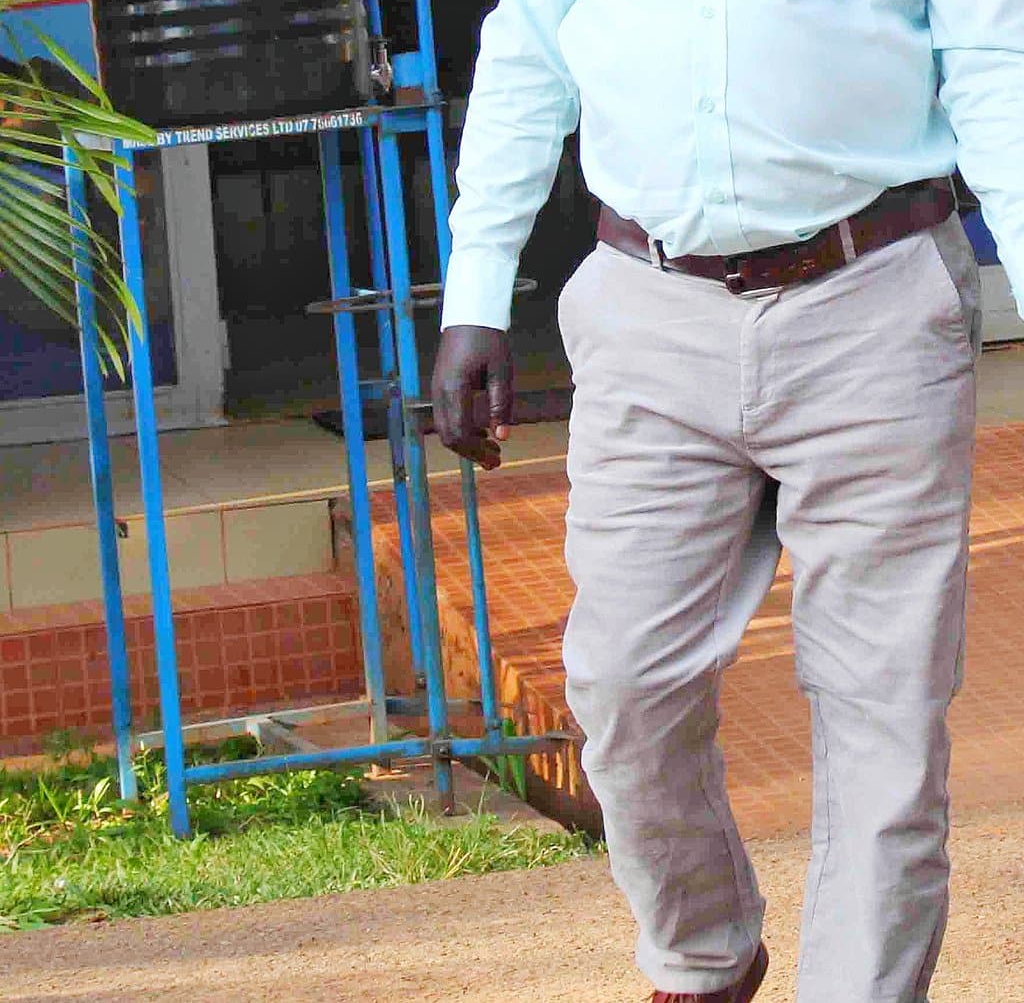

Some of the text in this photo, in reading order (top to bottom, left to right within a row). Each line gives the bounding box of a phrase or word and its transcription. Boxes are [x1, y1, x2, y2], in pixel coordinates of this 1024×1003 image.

[156, 132, 173, 145] BY
[175, 128, 213, 144] TREND
[215, 123, 270, 140] SERVICES
[272, 121, 293, 135] LTD
